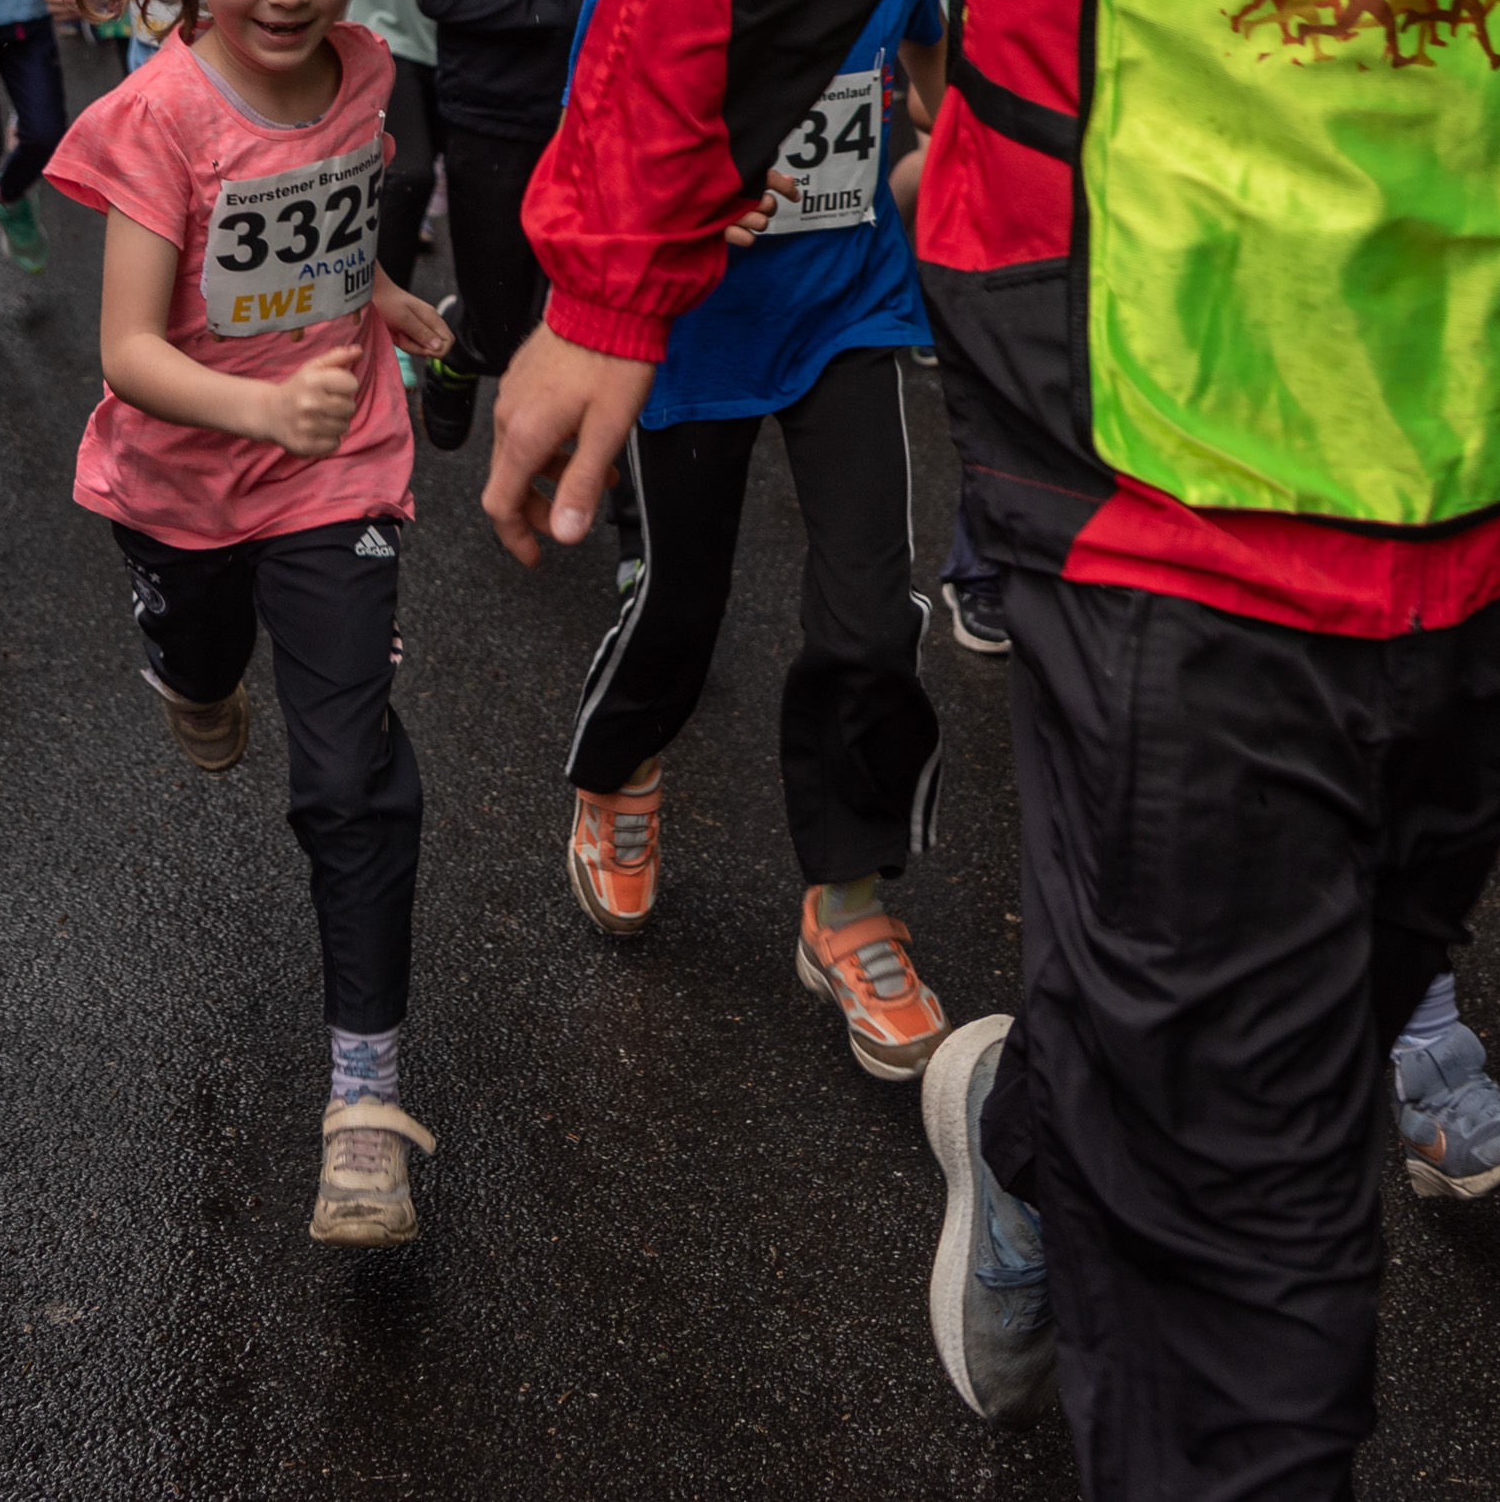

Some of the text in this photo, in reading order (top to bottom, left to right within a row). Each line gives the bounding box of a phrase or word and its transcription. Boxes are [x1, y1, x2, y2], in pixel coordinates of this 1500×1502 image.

[820, 84, 872, 101] nenlauf
[765, 102, 876, 170] 34
[226, 178, 315, 206] Everstener
[802, 189, 862, 214] bruns
[299, 247, 366, 279] Anouk
[231, 259, 376, 323] EWE bru
